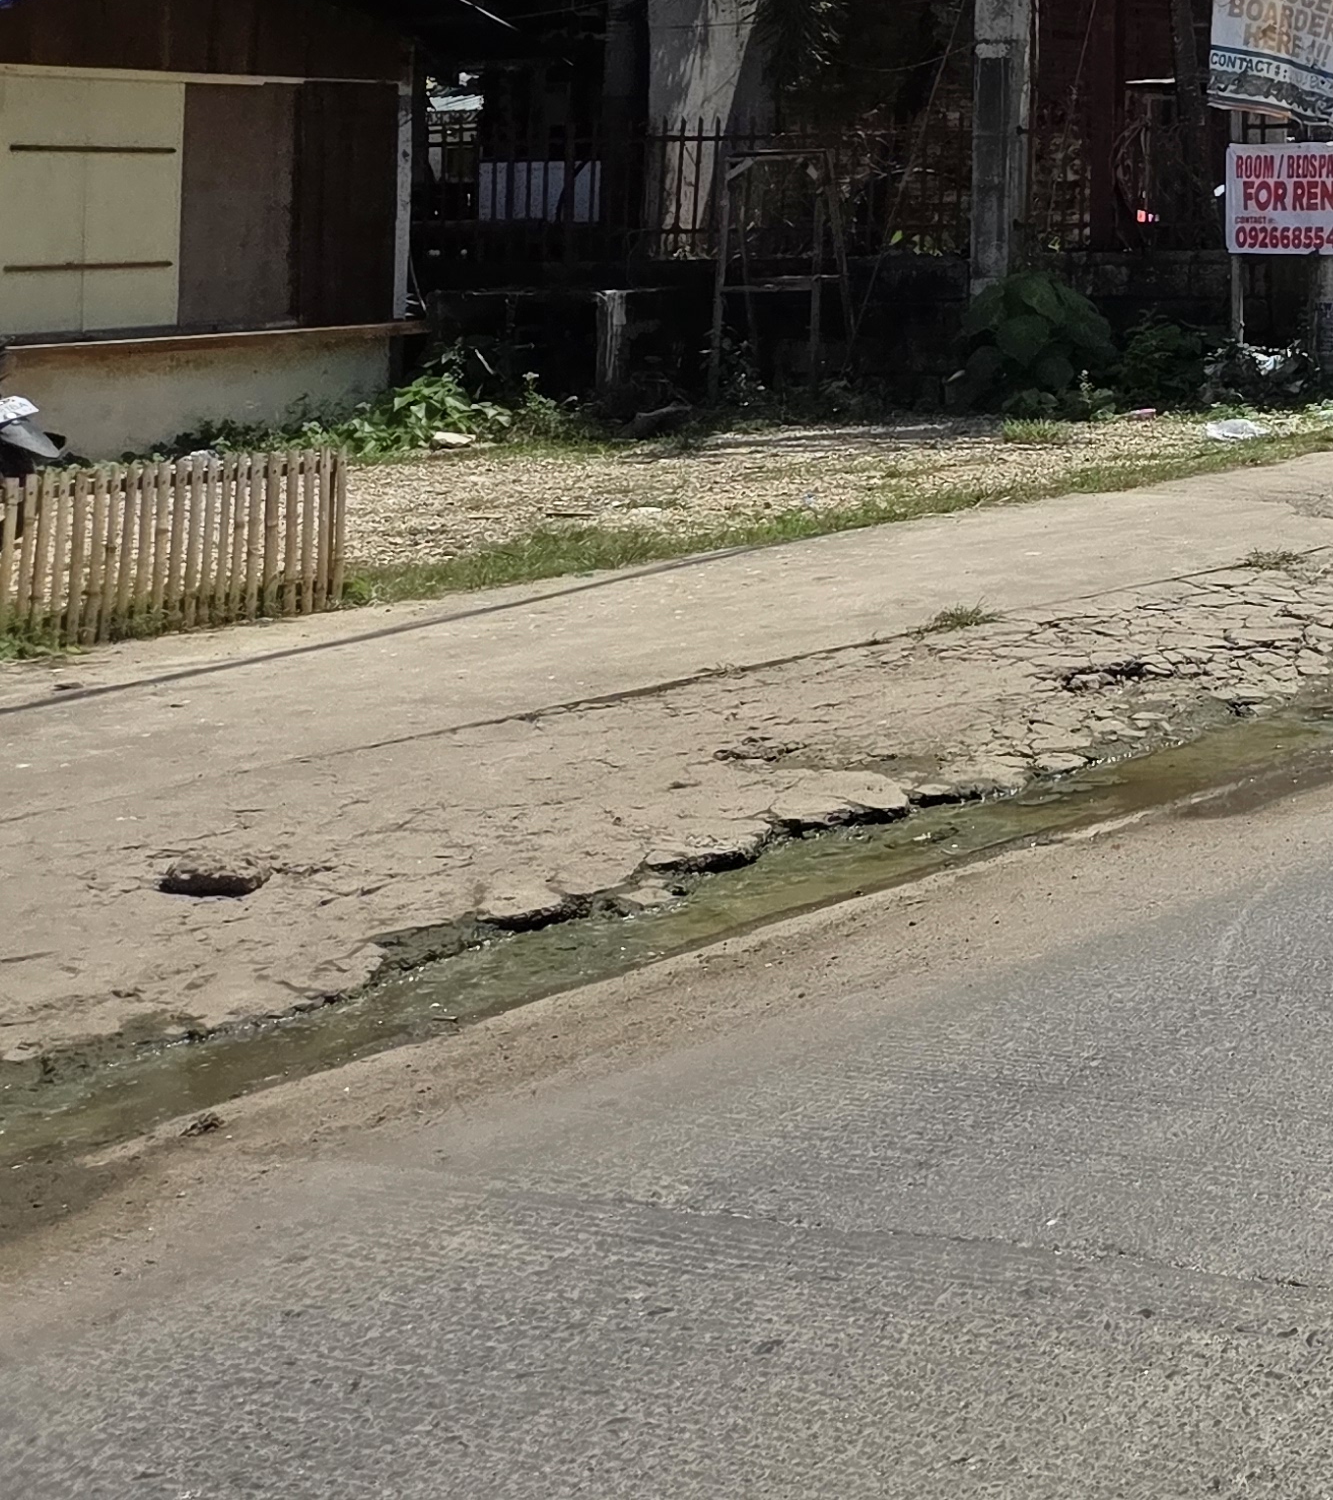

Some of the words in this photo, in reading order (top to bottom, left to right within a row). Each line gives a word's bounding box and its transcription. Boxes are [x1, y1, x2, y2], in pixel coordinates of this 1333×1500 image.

[1244, 22, 1302, 59] HERE
[1236, 155, 1274, 179] ROOM
[1277, 154, 1284, 179] /
[1243, 180, 1287, 211] FOR
